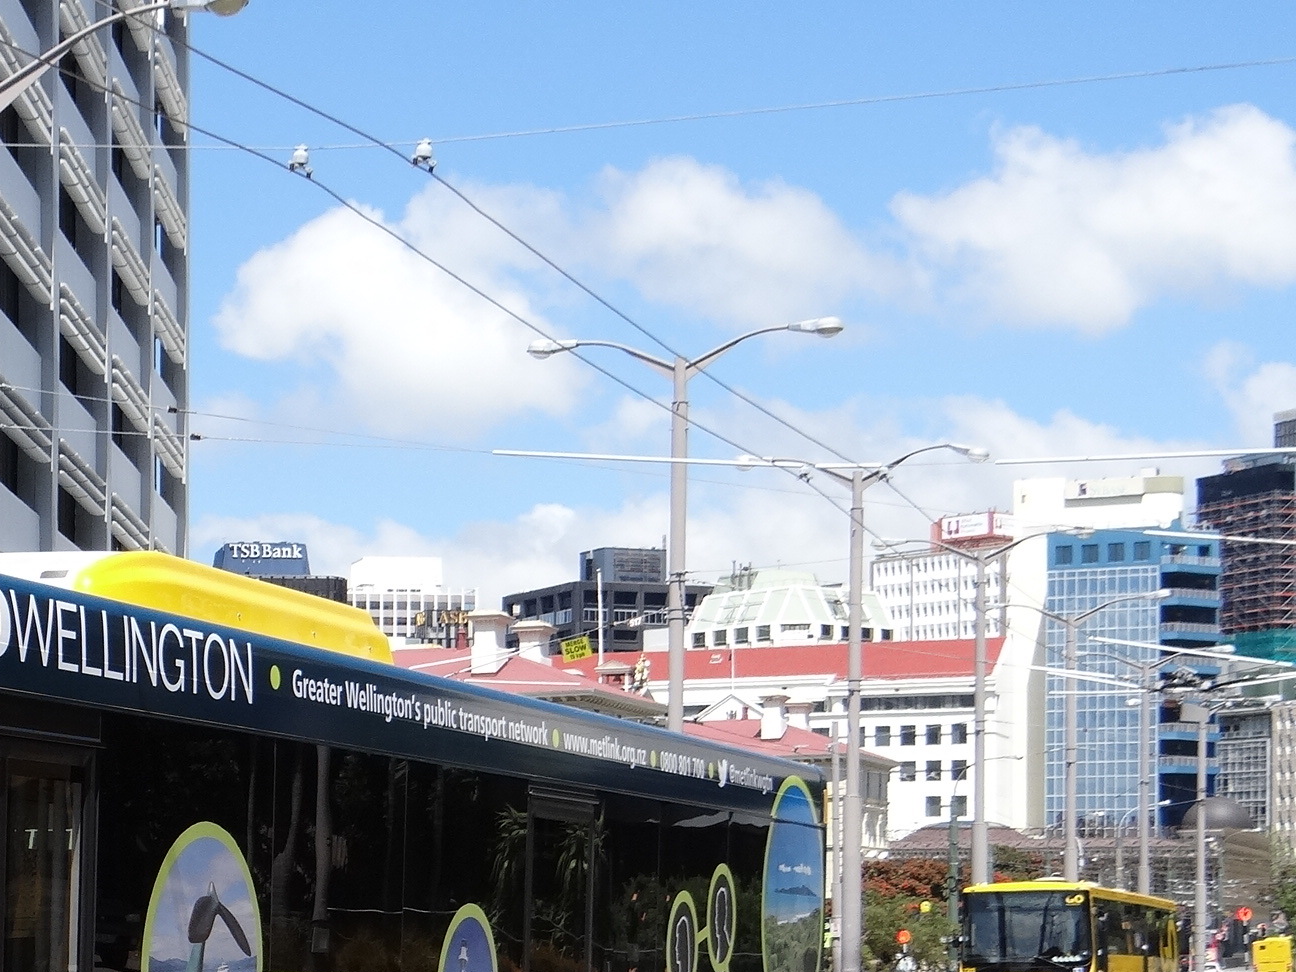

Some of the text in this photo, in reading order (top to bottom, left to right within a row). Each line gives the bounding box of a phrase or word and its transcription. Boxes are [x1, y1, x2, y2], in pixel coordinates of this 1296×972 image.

[229, 543, 303, 559] TSB Bank
[565, 643, 587, 655] SLOW
[292, 669, 548, 746] Greater Wellington's public transport network
[562, 732, 647, 769] www.metlink.org.nz
[660, 751, 679, 773] 0800
